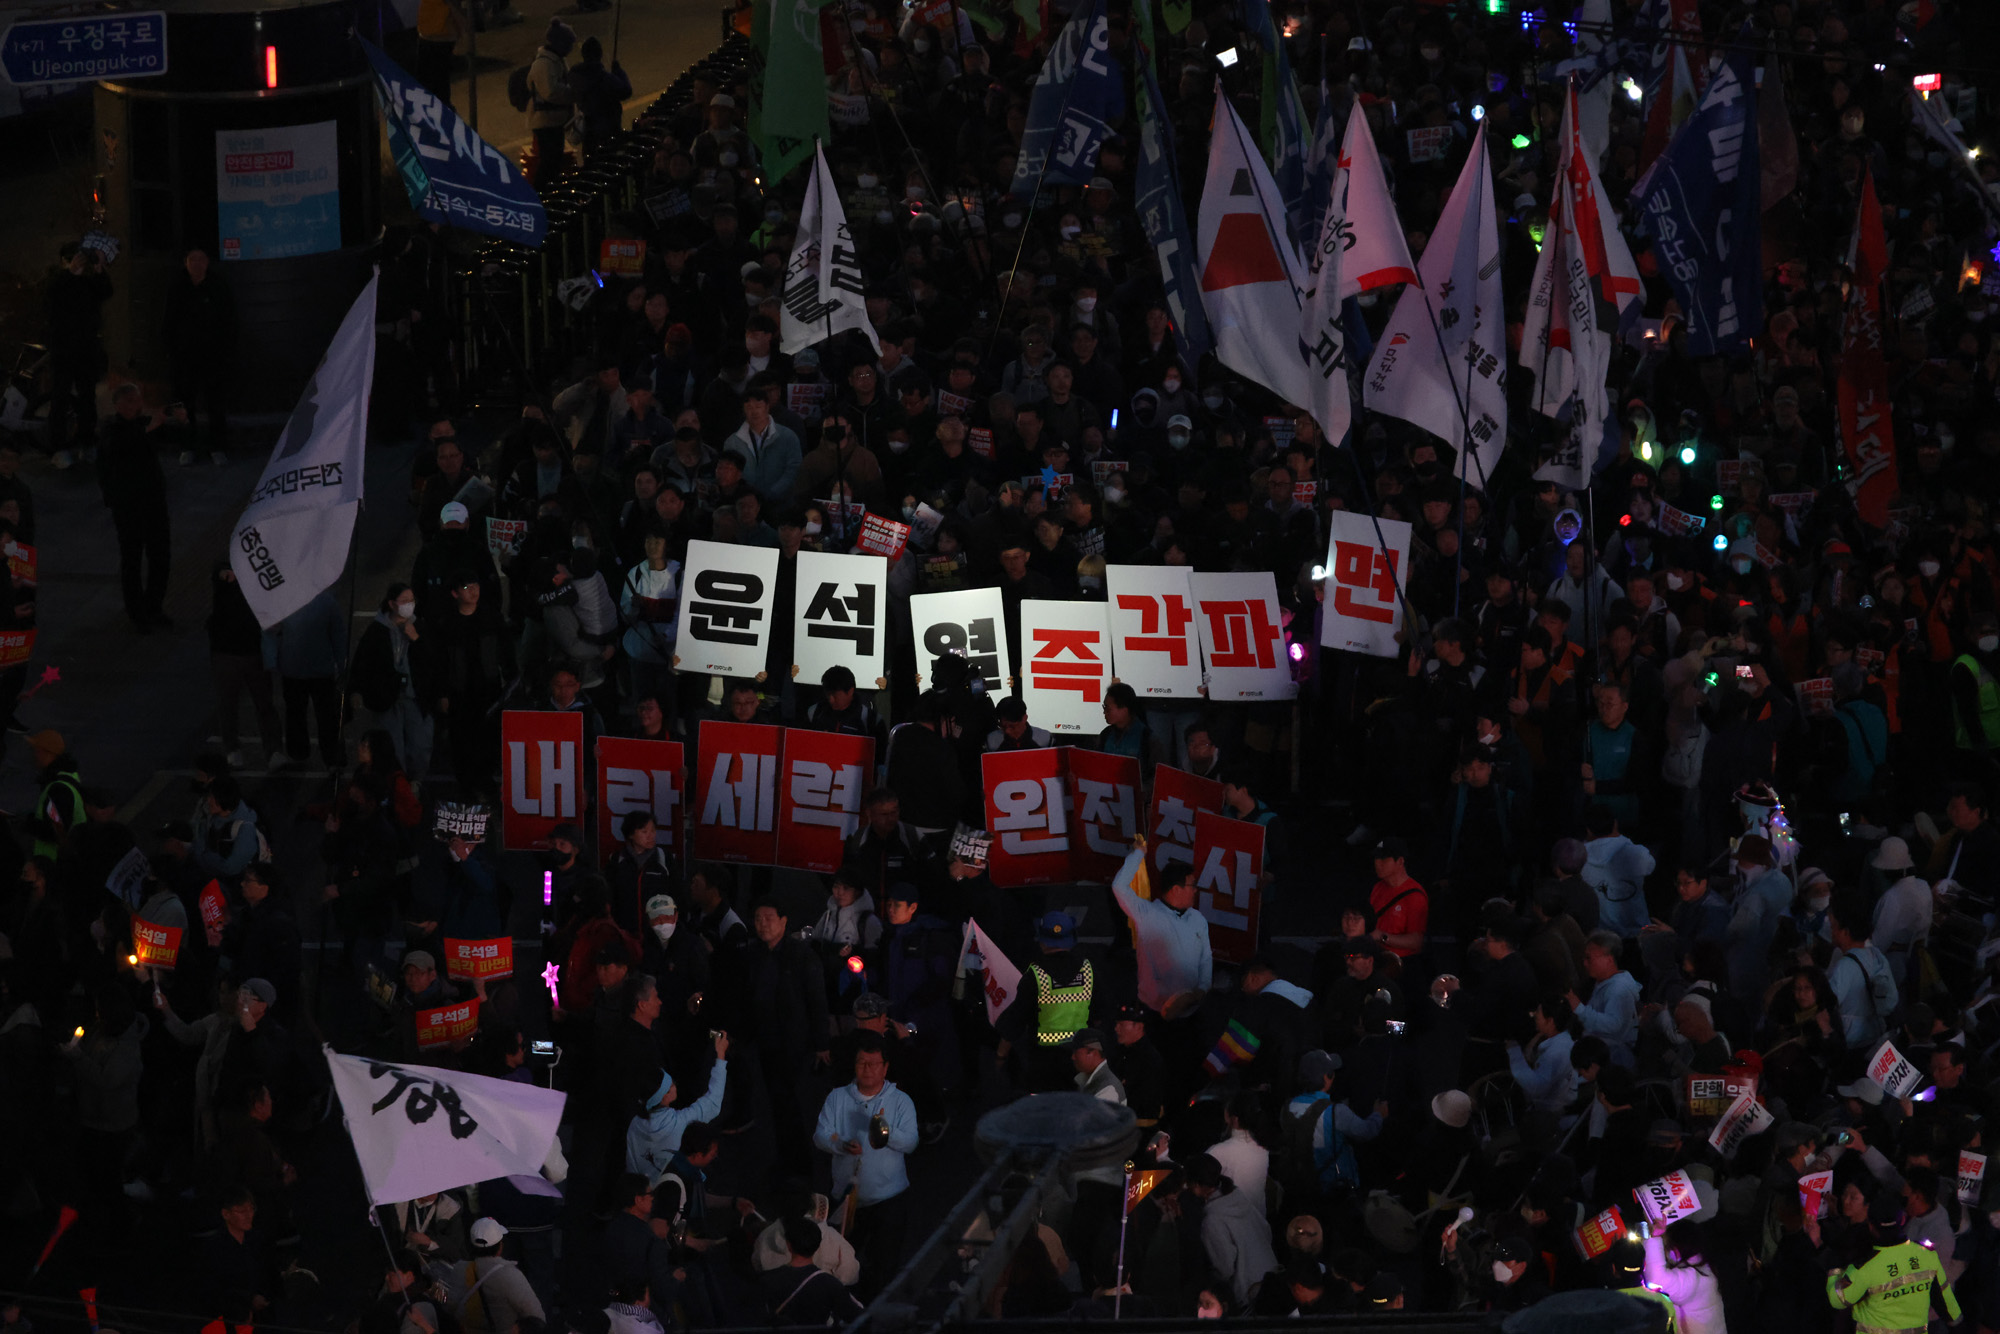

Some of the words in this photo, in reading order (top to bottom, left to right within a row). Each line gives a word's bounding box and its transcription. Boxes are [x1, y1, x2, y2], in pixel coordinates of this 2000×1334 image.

[32, 54, 157, 79] Ujeongguk-ro
[57, 22, 156, 52] 우정국로
[226, 153, 291, 170] 안전운전이
[689, 569, 763, 646] 윤
[803, 582, 876, 656] 석
[1334, 540, 1399, 624] 면
[924, 617, 1002, 691] 열
[1031, 628, 1103, 702] 즉
[1116, 594, 1192, 666] 각
[1199, 599, 1280, 669] 파
[508, 740, 576, 818] 내
[606, 767, 680, 845] 란
[701, 752, 776, 831] 세
[790, 760, 863, 840] 력
[993, 776, 1075, 855] 완
[1078, 778, 1137, 858] 전
[1196, 846, 1258, 932] 산
[448, 957, 475, 973] 즉각
[479, 956, 510, 973] 파면!
[458, 944, 498, 958] 윤석열
[419, 1025, 448, 1040] 즉각
[430, 1006, 470, 1025] 윤석열
